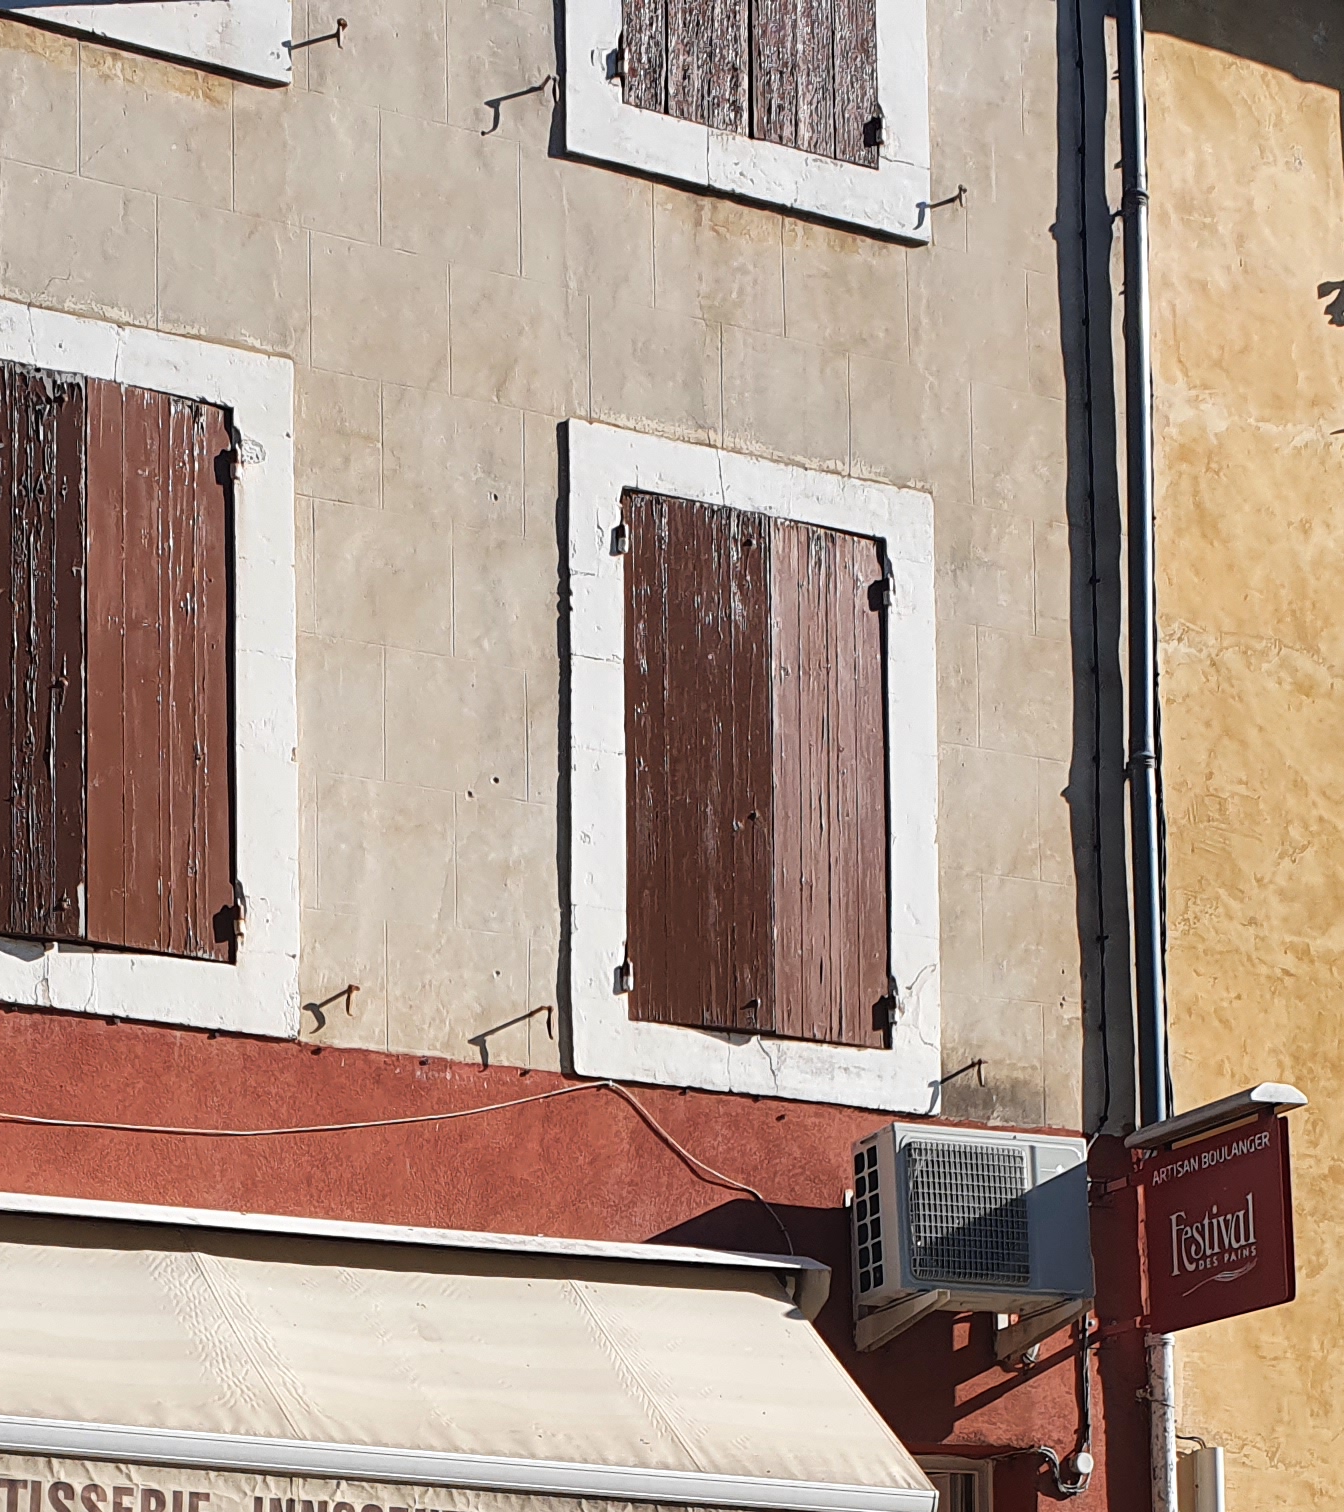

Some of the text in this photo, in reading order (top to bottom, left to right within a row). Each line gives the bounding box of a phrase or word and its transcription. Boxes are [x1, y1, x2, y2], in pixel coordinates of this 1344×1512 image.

[1152, 1132, 1270, 1186] ARTISAN BOULANGER
[1170, 1192, 1257, 1276] Festival
[1199, 1246, 1257, 1270] DES PAINS
